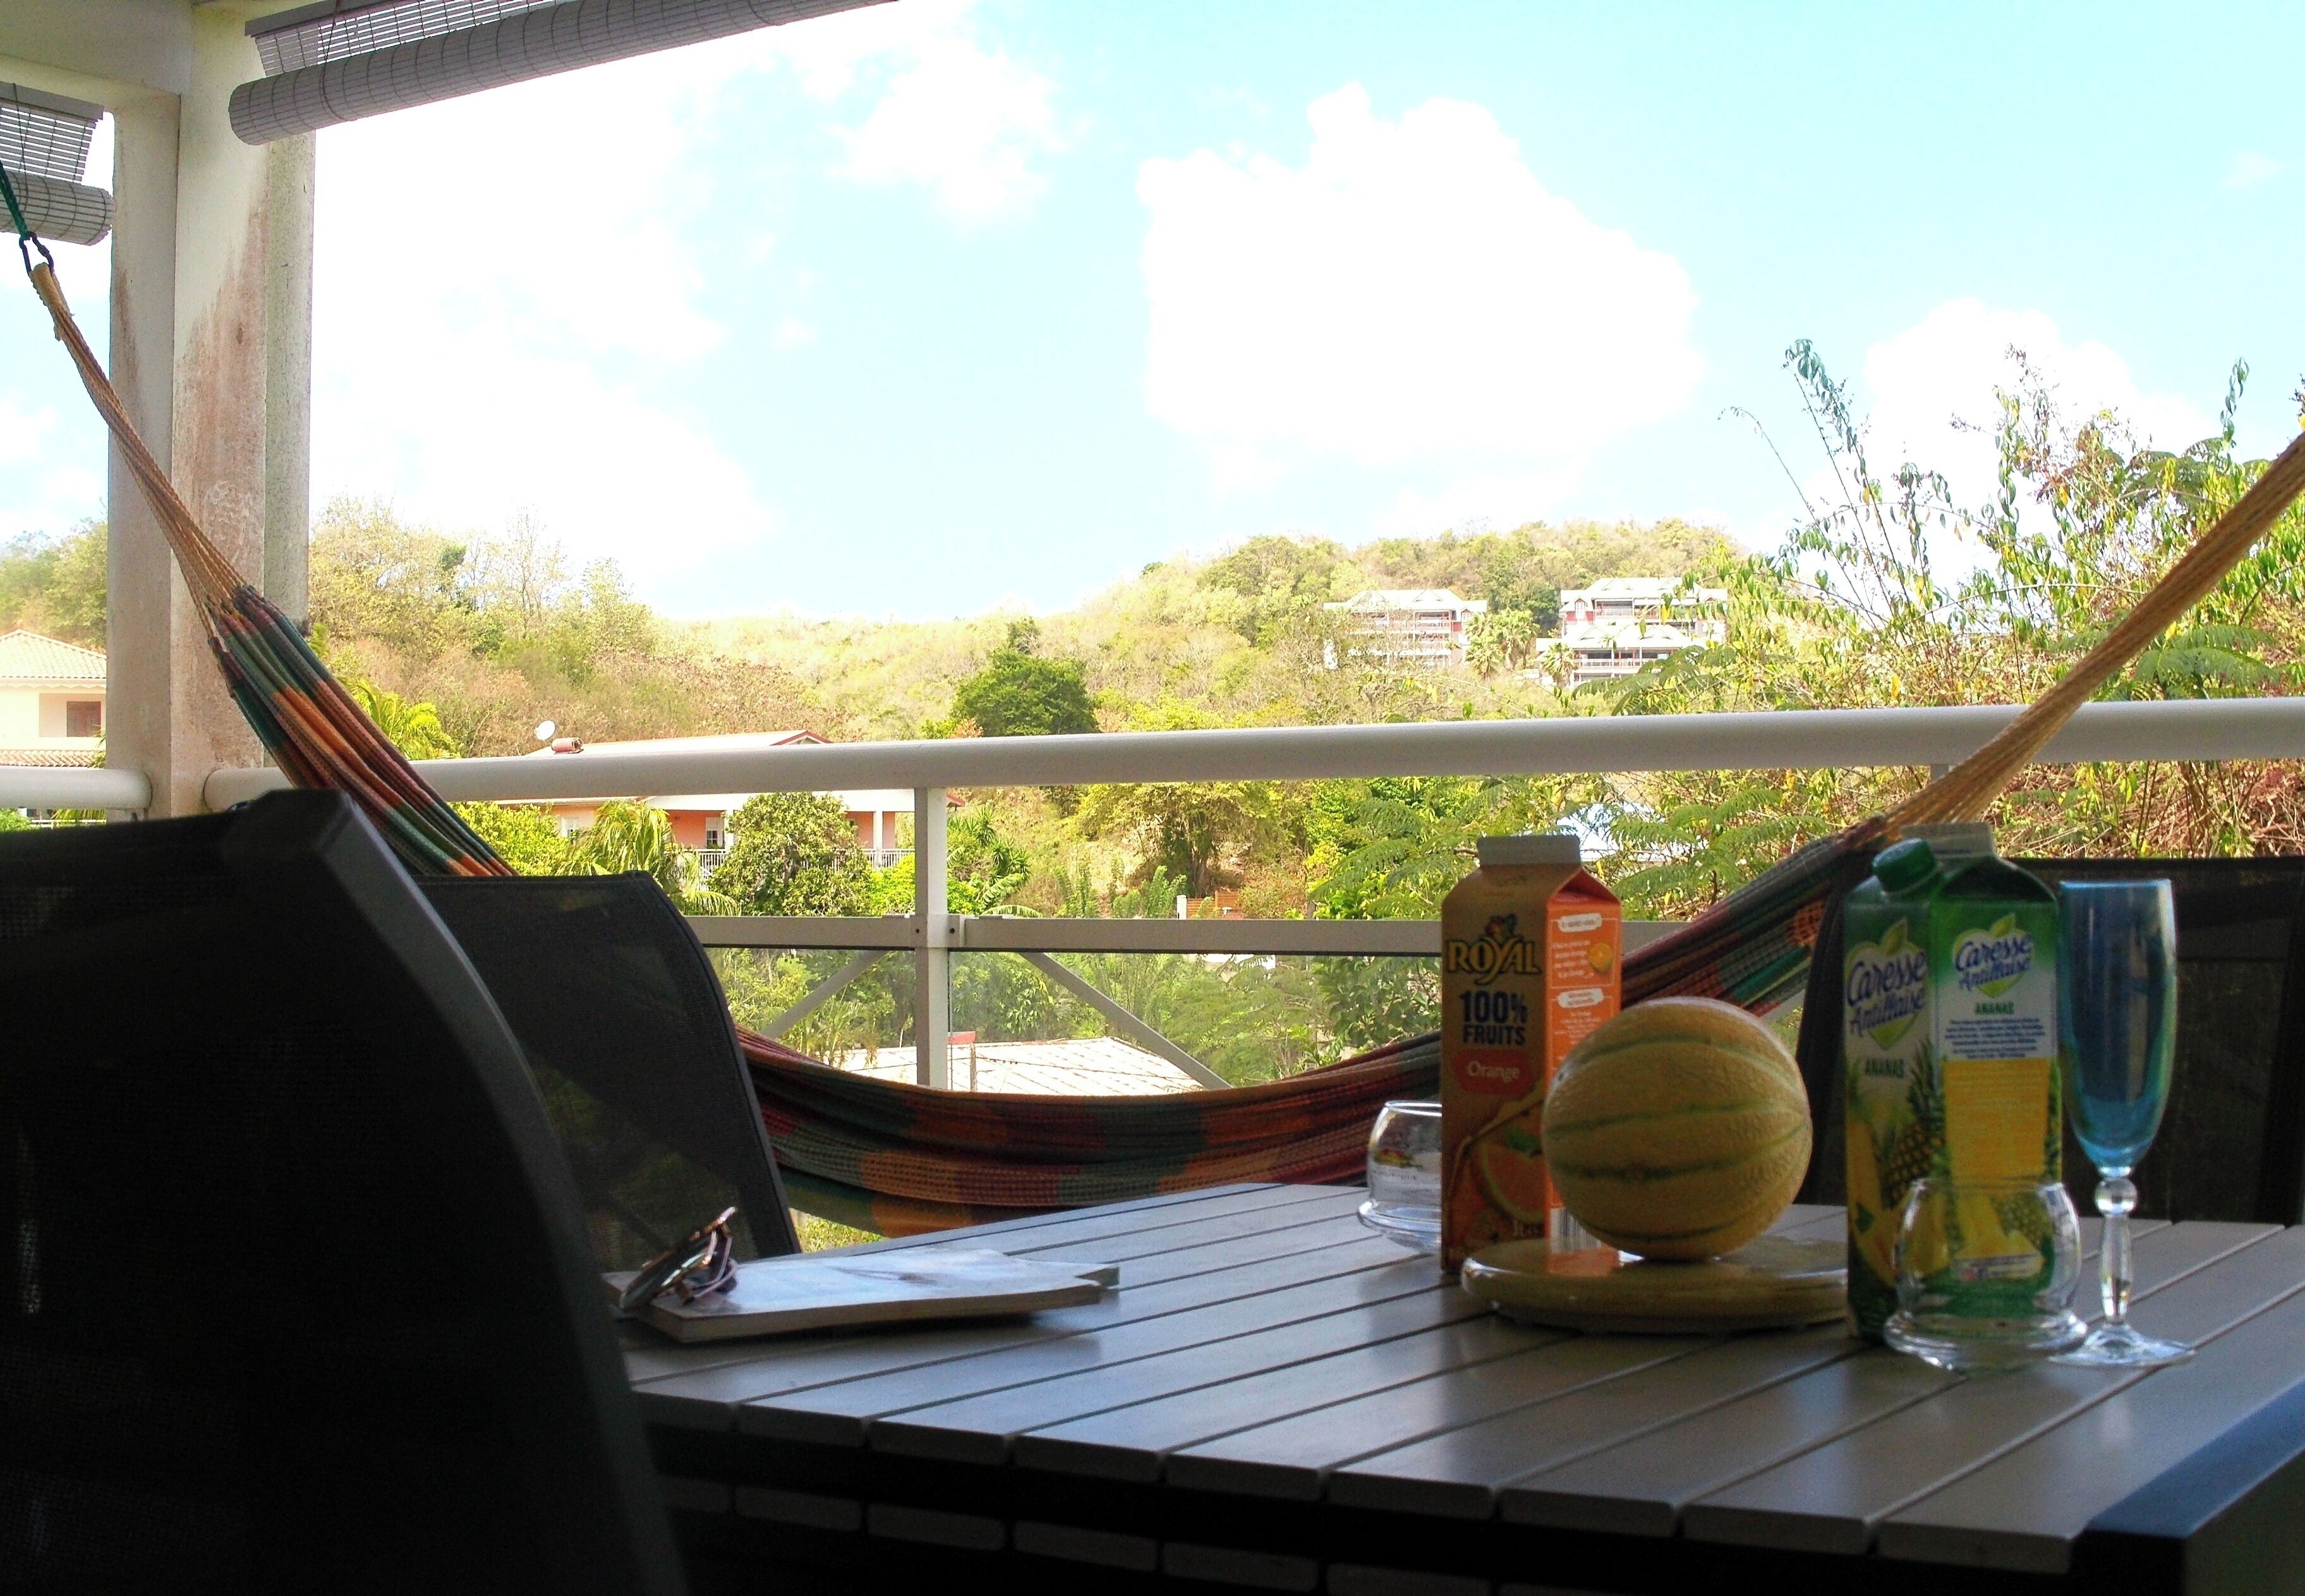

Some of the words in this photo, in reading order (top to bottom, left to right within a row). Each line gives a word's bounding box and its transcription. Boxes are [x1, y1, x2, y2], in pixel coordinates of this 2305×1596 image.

[1446, 935, 1542, 986] ROYAL
[1956, 931, 2032, 972] Caresse
[1847, 950, 1926, 1007] Caresse
[1460, 990, 1528, 1024] 100%
[1463, 1024, 1526, 1046] FRUITS
[1467, 1060, 1521, 1083] Orange
[1865, 1057, 1905, 1078] ANANAS
